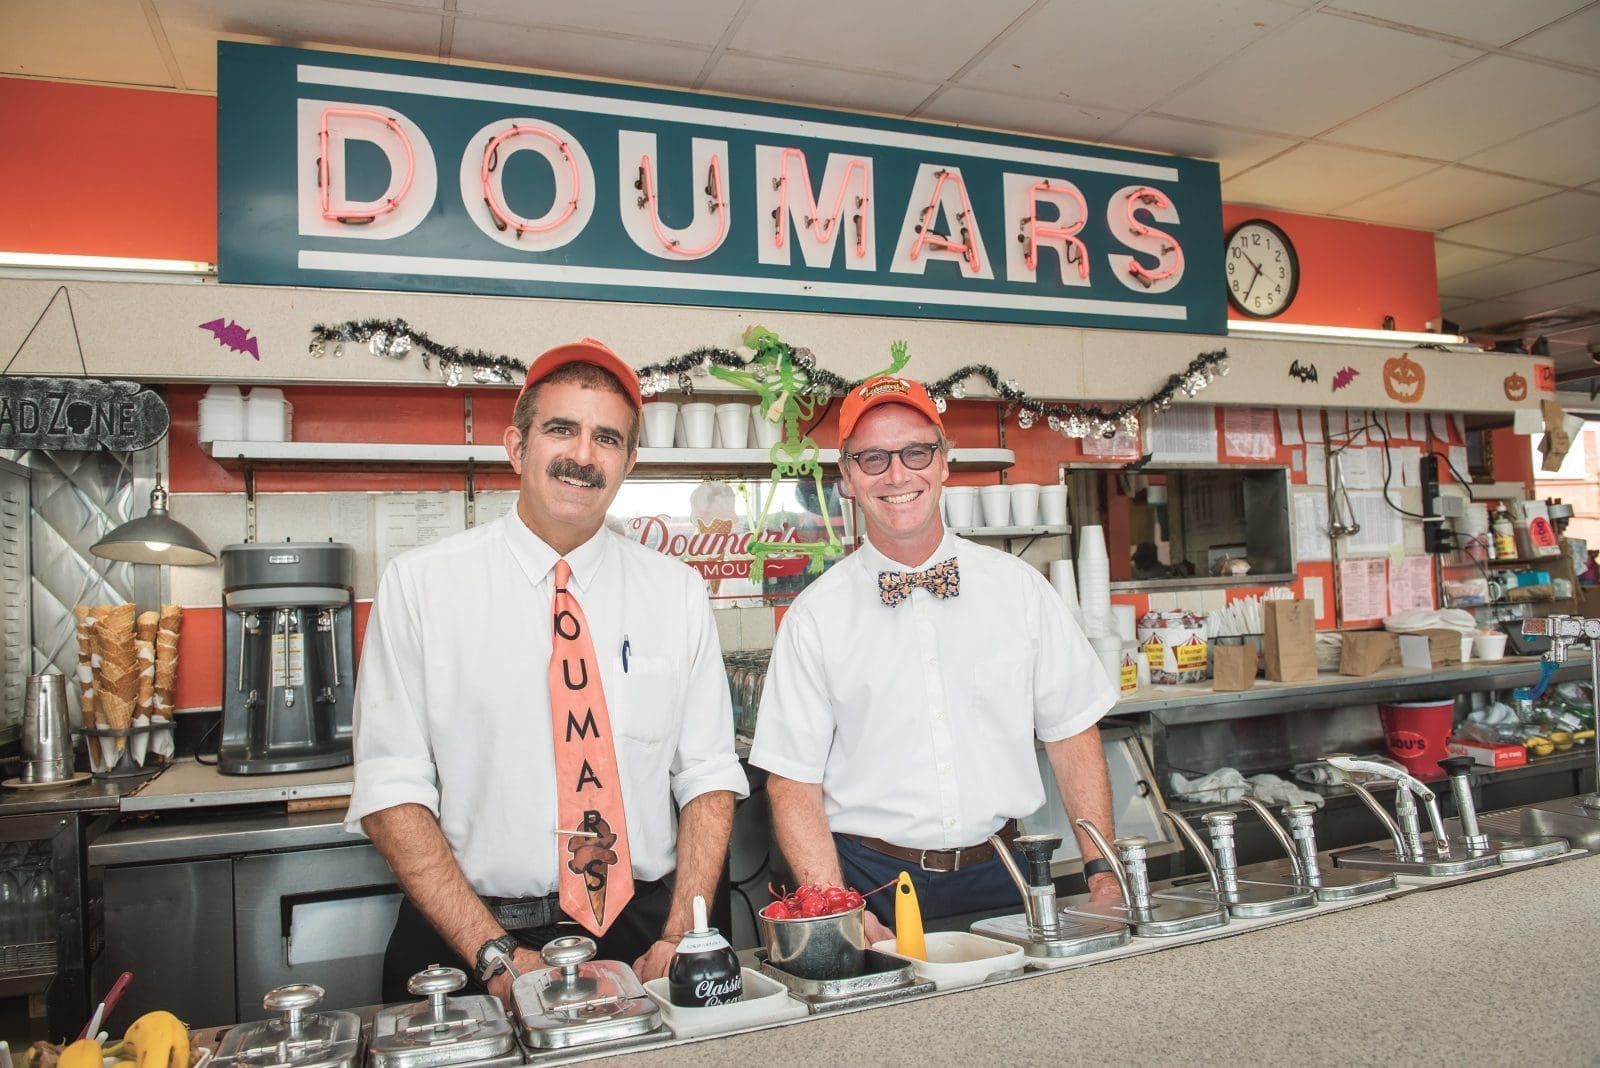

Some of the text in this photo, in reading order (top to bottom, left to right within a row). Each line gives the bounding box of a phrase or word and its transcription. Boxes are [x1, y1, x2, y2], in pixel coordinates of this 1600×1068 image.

[297, 98, 1185, 295] DOUMARS
[1241, 236, 1249, 249] 11
[1251, 234, 1261, 246] 12
[1231, 246, 1242, 259] 10
[1275, 250, 1281, 262] 2
[1228, 263, 1235, 275] 9
[1279, 267, 1285, 279] 3
[1232, 280, 1239, 292] 8
[1275, 284, 1281, 294] 4
[1254, 296, 1261, 308] 6
[1267, 293, 1273, 305] 5
[554, 587, 606, 892] OUMARS
